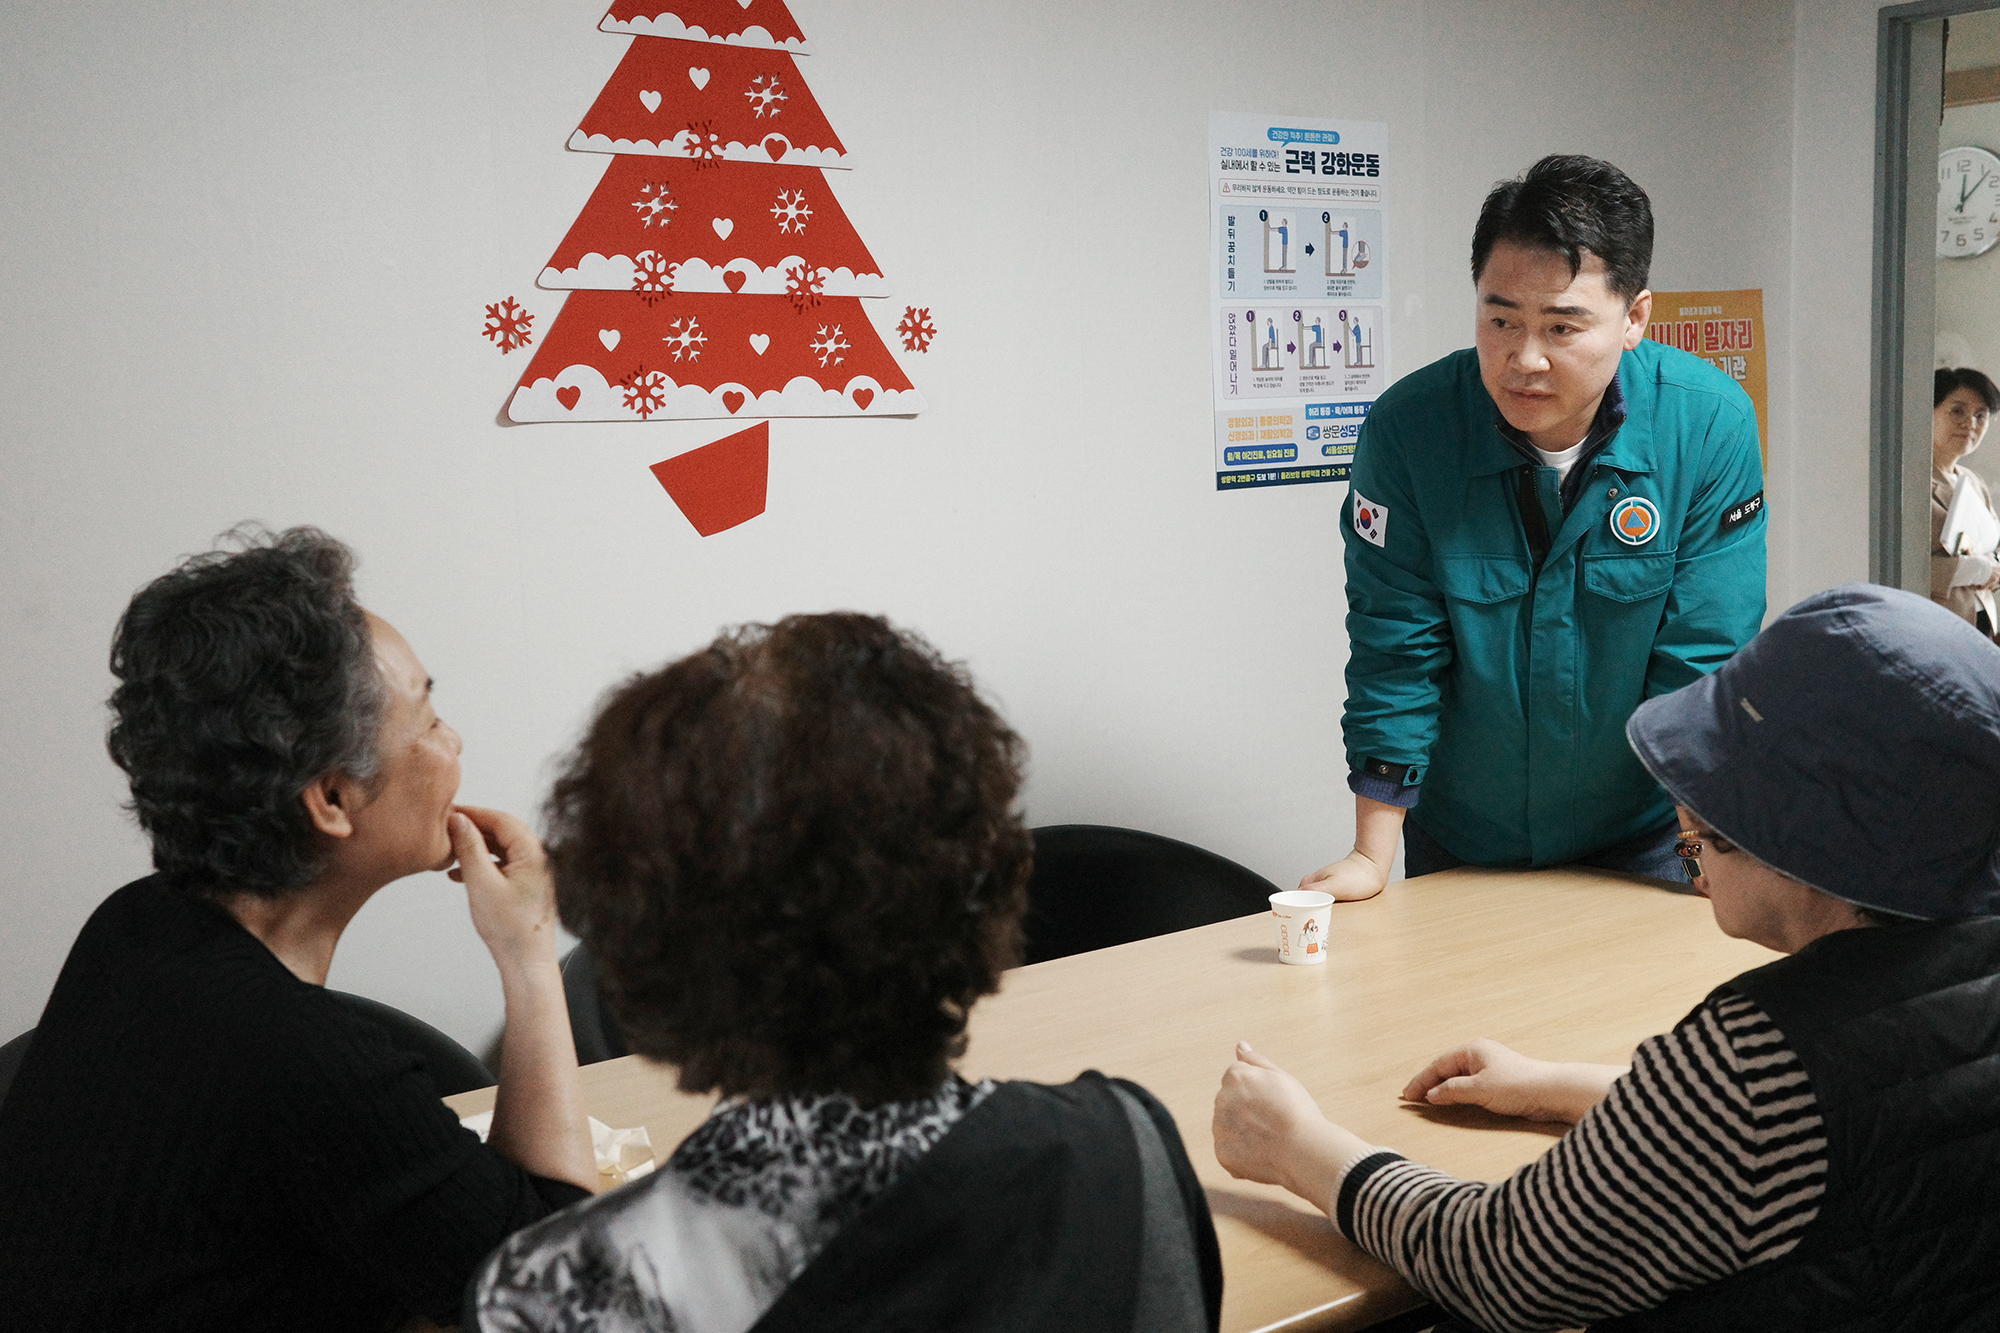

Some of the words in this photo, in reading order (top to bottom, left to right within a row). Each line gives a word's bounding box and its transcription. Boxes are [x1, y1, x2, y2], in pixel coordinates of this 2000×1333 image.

[1272, 130, 1289, 140] 건강한
[1304, 132, 1321, 141] 튼튼한
[1220, 147, 1233, 157] 건강
[1235, 148, 1258, 158] 100세를
[1259, 149, 1279, 159] 위하여!
[1221, 159, 1249, 171] 실내에서
[1251, 160, 1257, 171] 할
[1259, 161, 1266, 171] 수
[1267, 161, 1280, 172] 있는
[1285, 149, 1316, 174] 근력
[1321, 152, 1380, 177] 강화운동
[1957, 160, 1970, 172] 12
[1941, 167, 1950, 180] 11
[1989, 176, 2000, 188] 2
[1232, 184, 1251, 192] 무리하지
[1252, 184, 1261, 193] 않게
[1287, 186, 1296, 195] 약간
[1307, 187, 1316, 195] 드는
[1318, 188, 1330, 196] 정도로
[1332, 188, 1350, 196] 운동하는
[1350, 189, 1359, 197] 것이
[1941, 230, 1950, 243] 7
[1956, 234, 1967, 246] 6
[1974, 228, 1984, 240] 5
[1704, 318, 1753, 353] 일자리
[1229, 349, 1237, 395] 일어나기
[1308, 407, 1319, 416] 허리
[1320, 407, 1331, 416] 통증
[1335, 406, 1353, 415] 목/어깨
[1354, 405, 1364, 414] 통증
[1228, 417, 1254, 428] 정형외과
[1260, 415, 1293, 426] 통증의학과
[1229, 431, 1254, 441] 신경외과
[1260, 429, 1293, 439] 재활의학과
[1266, 449, 1283, 458] 일요일
[1284, 448, 1295, 457] 진료
[1221, 475, 1236, 484] 쌍문역
[1237, 474, 1256, 482] 2번출구
[1256, 473, 1267, 481] 도보
[1281, 471, 1300, 479] 올리브영
